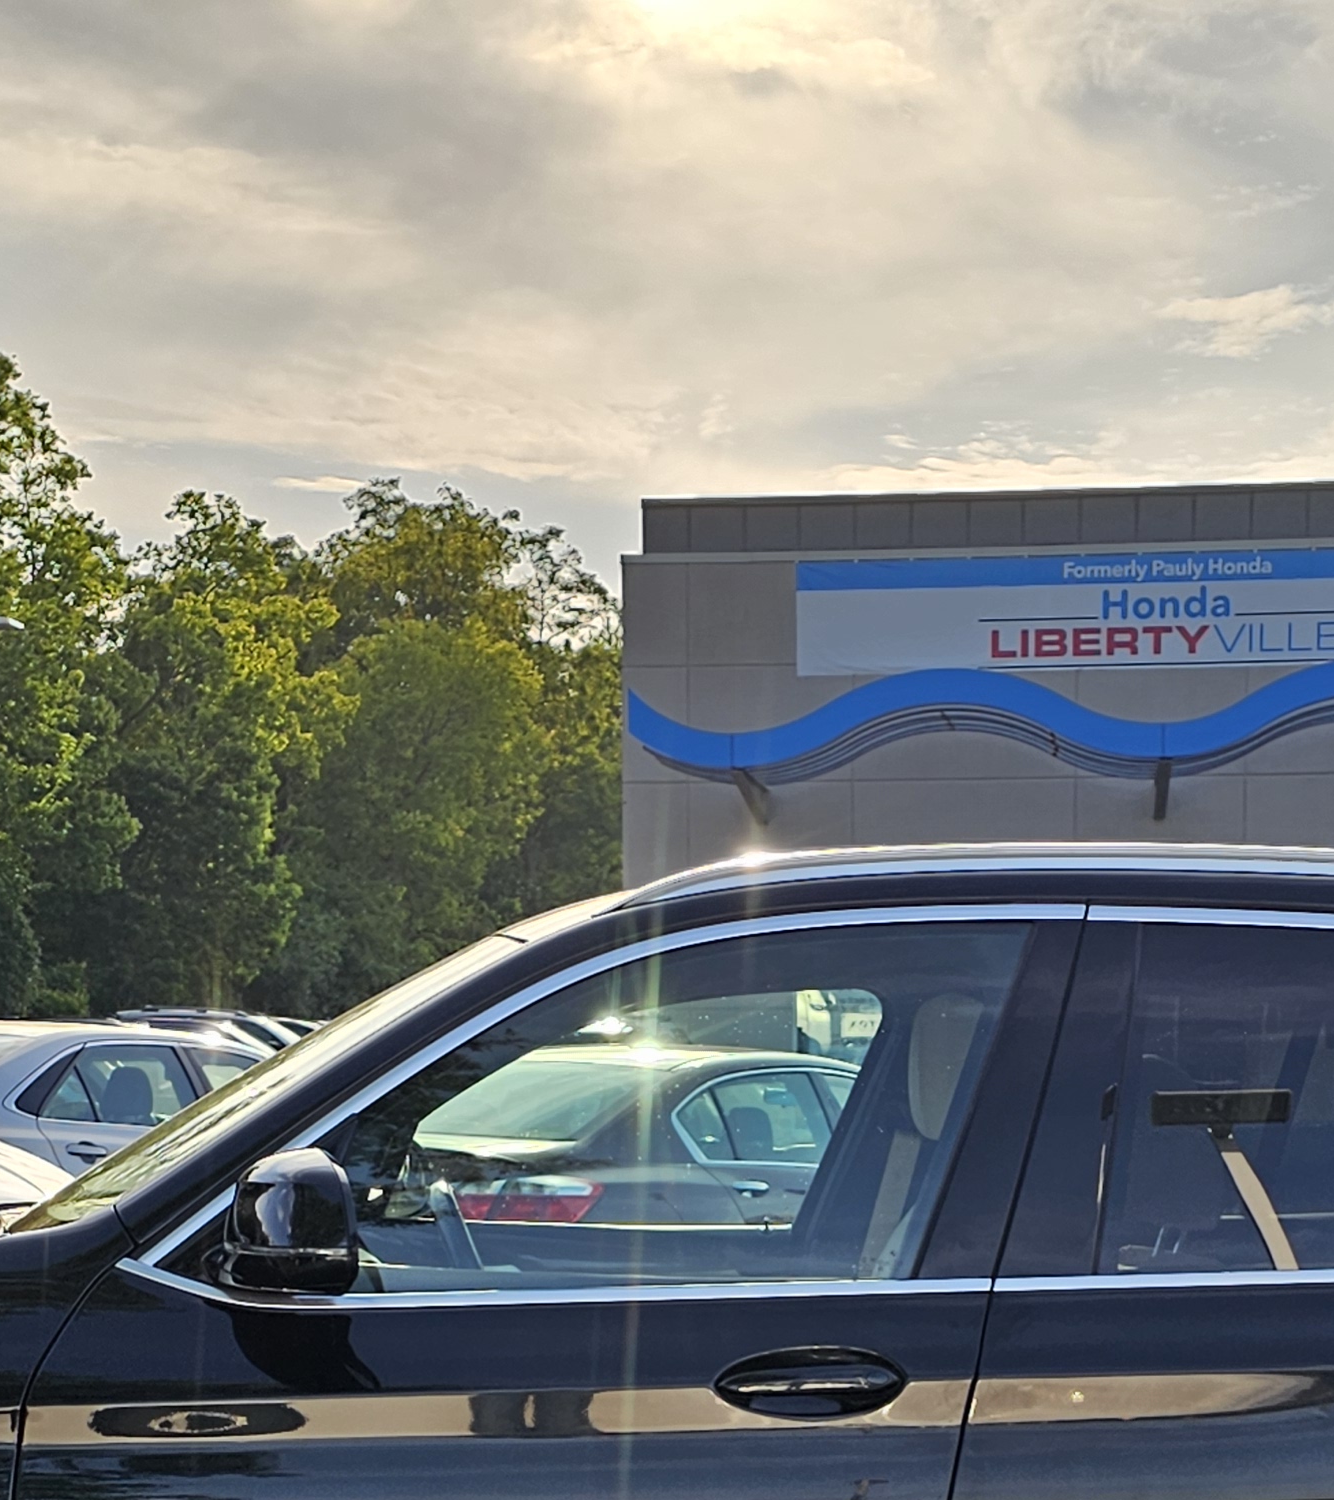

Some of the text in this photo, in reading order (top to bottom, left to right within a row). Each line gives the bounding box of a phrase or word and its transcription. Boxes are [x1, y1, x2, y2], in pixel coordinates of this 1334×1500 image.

[1063, 556, 1273, 581] Formerly Pauly Honda
[1101, 585, 1231, 620] Honda
